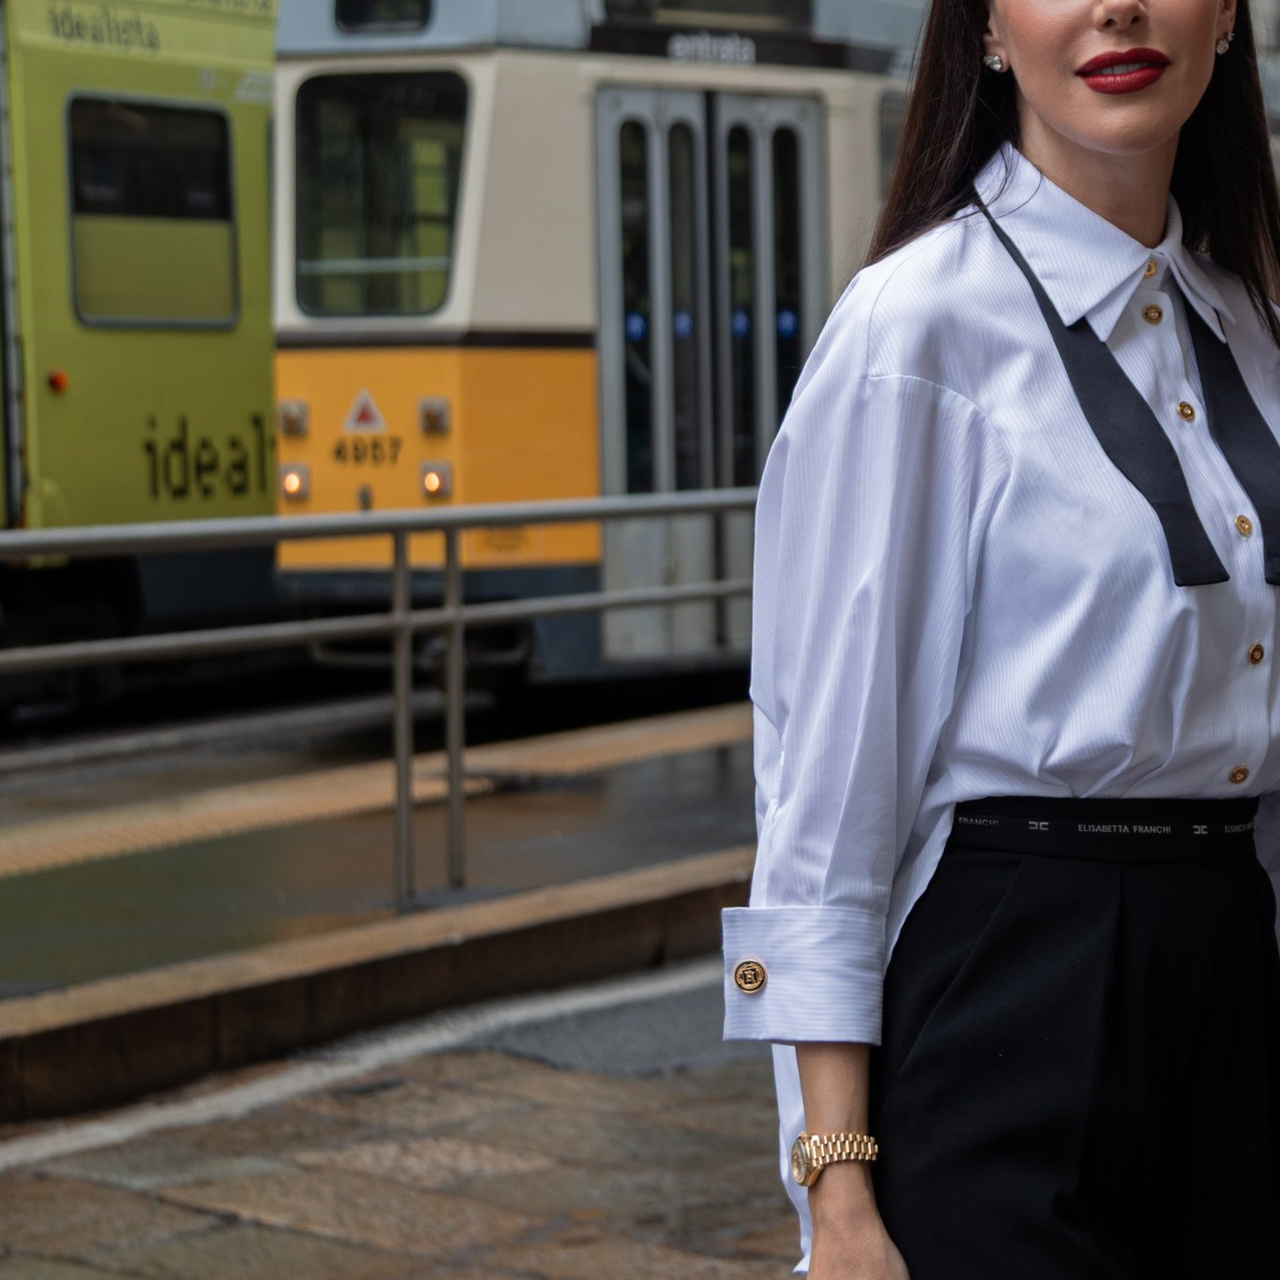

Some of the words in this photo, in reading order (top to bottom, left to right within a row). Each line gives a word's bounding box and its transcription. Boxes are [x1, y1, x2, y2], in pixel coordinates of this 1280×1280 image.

[49, 1, 161, 52] idealista
[144, 414, 277, 498] ideal
[1078, 824, 1130, 833] ELISABETTA
[1133, 825, 1172, 834] FRANCHI
